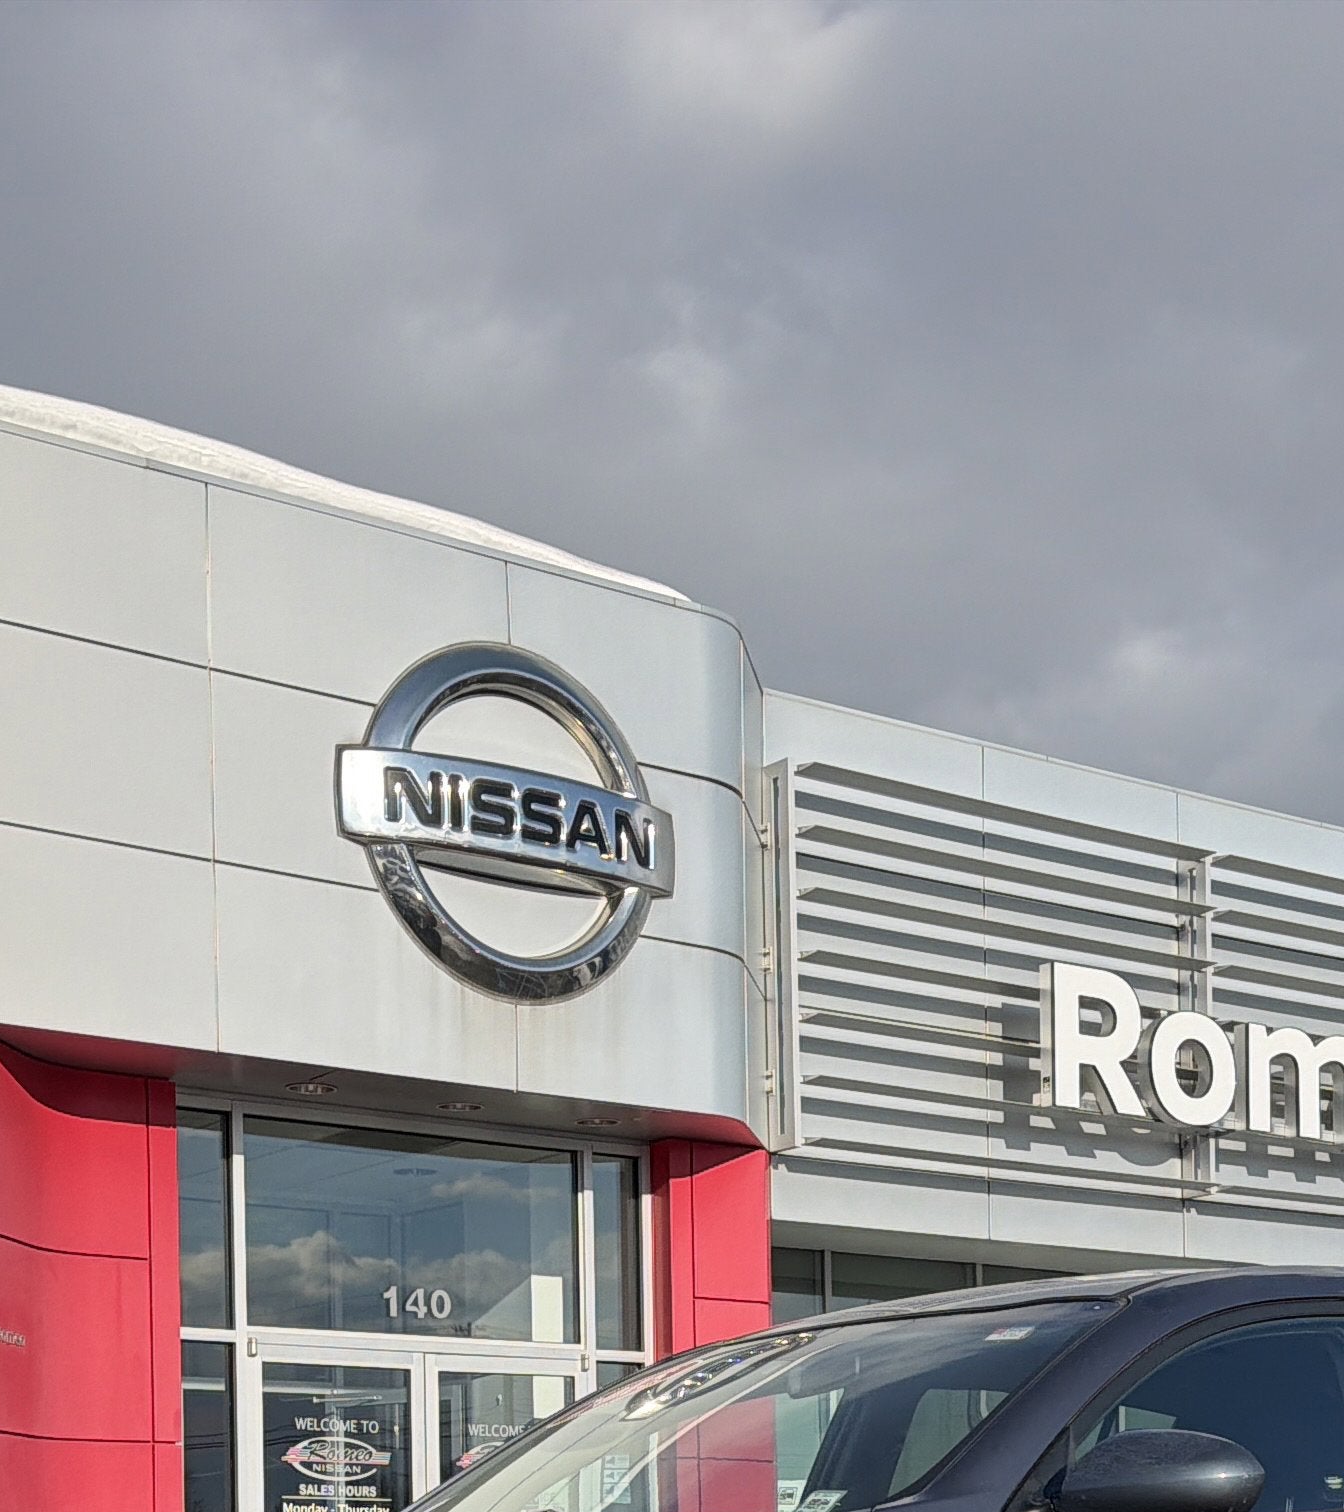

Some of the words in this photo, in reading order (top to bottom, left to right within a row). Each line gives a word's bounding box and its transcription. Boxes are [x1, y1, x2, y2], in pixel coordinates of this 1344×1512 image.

[383, 765, 656, 871] NISSAN
[383, 1285, 452, 1319] 140
[295, 1417, 358, 1432] WELCOME
[360, 1420, 379, 1433] TO
[308, 1440, 373, 1461] Romeo
[312, 1463, 362, 1474] NISSAN
[299, 1483, 335, 1496] SALES
[338, 1485, 377, 1498] HOURS
